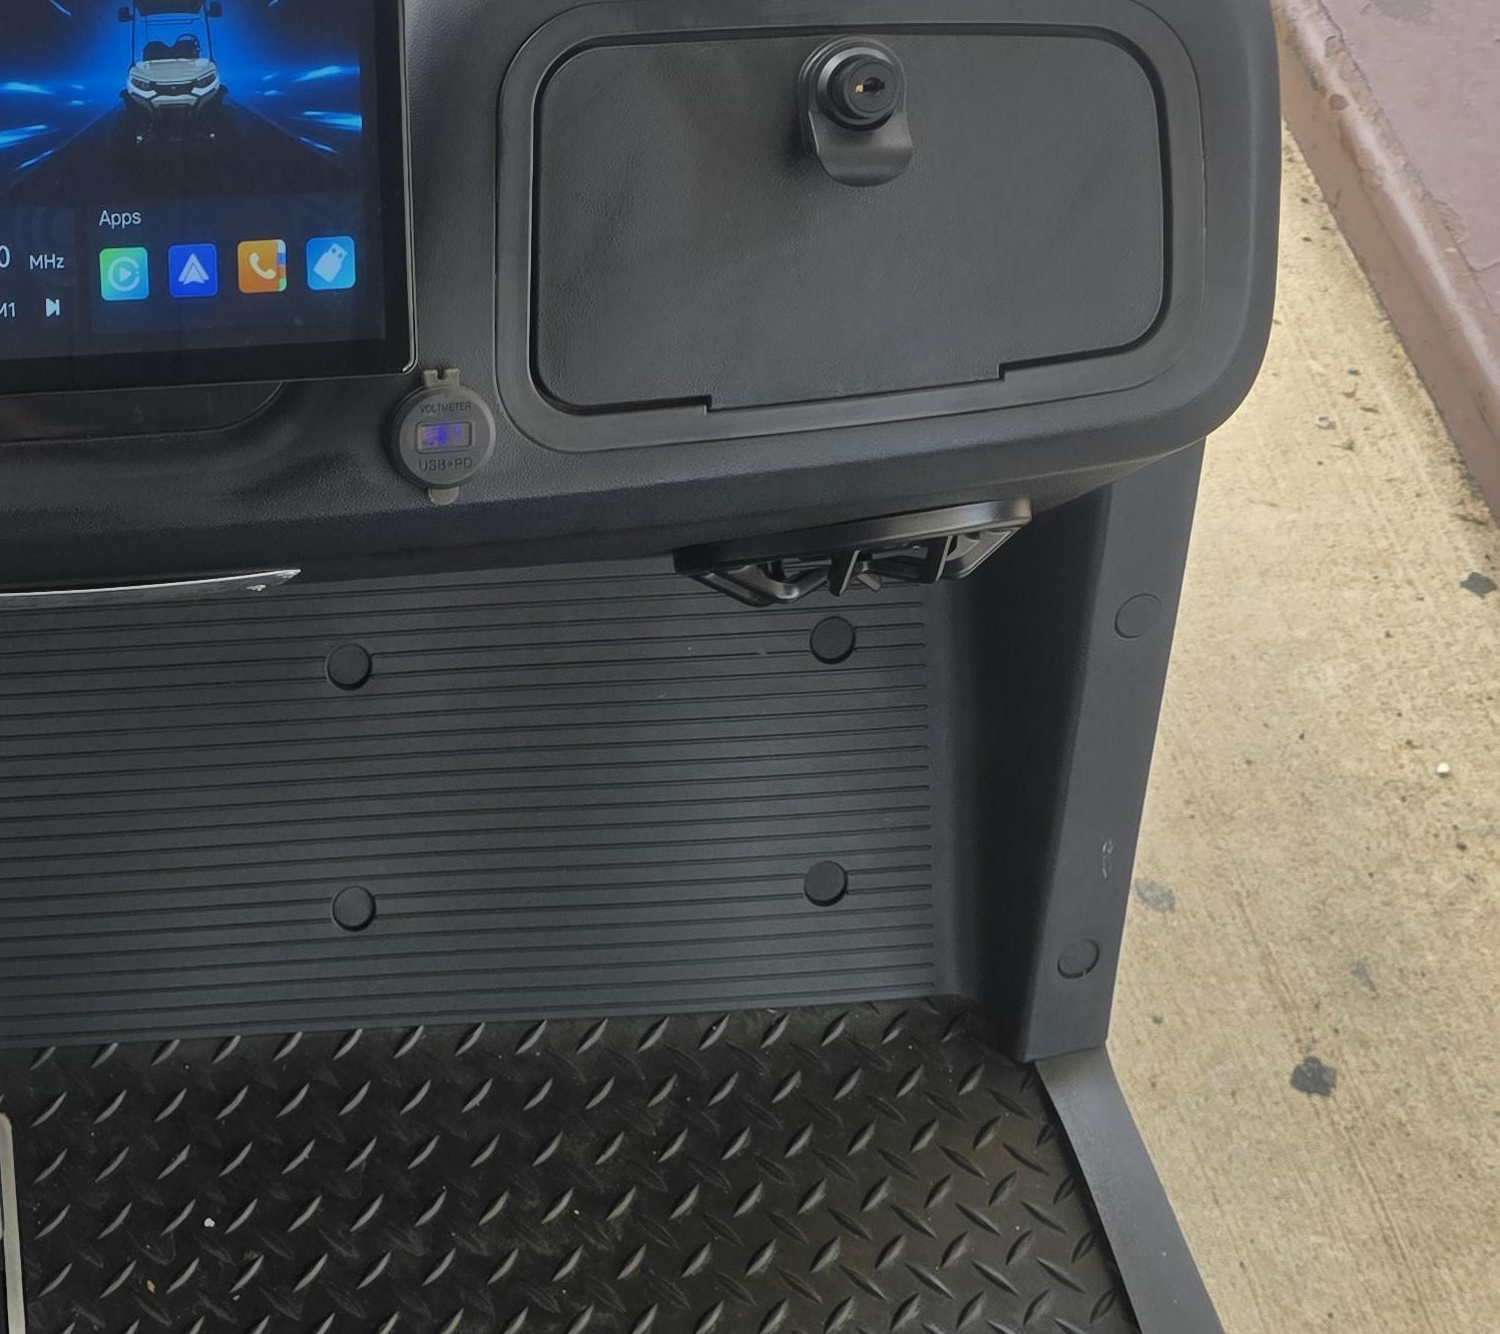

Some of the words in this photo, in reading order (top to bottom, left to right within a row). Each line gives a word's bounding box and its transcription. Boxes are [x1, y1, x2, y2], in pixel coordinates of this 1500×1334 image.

[98, 210, 142, 229] Apps
[29, 254, 65, 270] MHz
[419, 402, 472, 414] VOLTMETER
[418, 457, 473, 472] USB+PD
